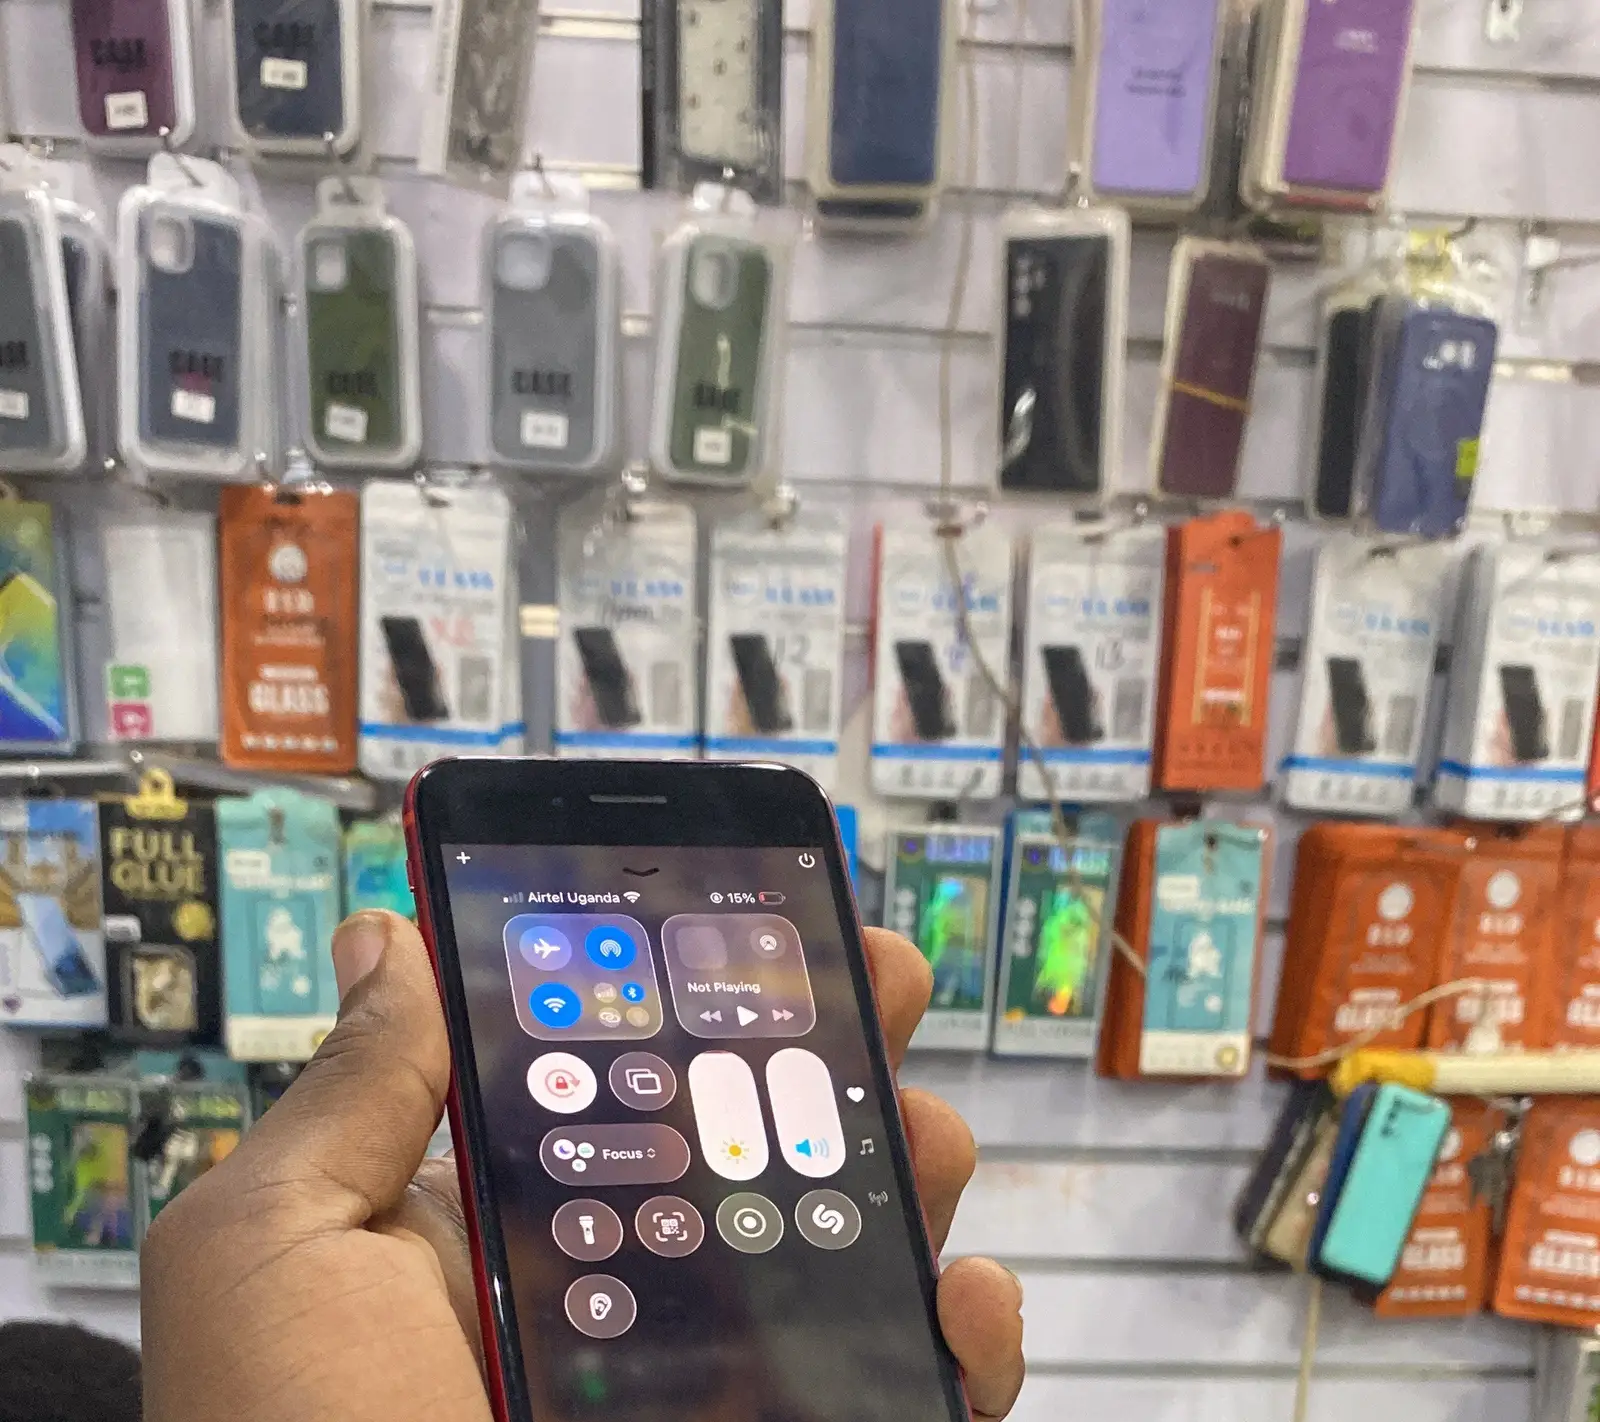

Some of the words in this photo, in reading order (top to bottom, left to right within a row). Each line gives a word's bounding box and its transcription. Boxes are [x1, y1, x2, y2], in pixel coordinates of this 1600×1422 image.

[108, 826, 204, 861] FULL
[110, 859, 206, 895] GLUE
[528, 891, 564, 904] Airtel
[566, 892, 621, 905] Uganda
[726, 892, 756, 904] 15%
[687, 982, 713, 993] Not
[715, 981, 762, 995] Playing
[602, 1148, 644, 1161] Focus
